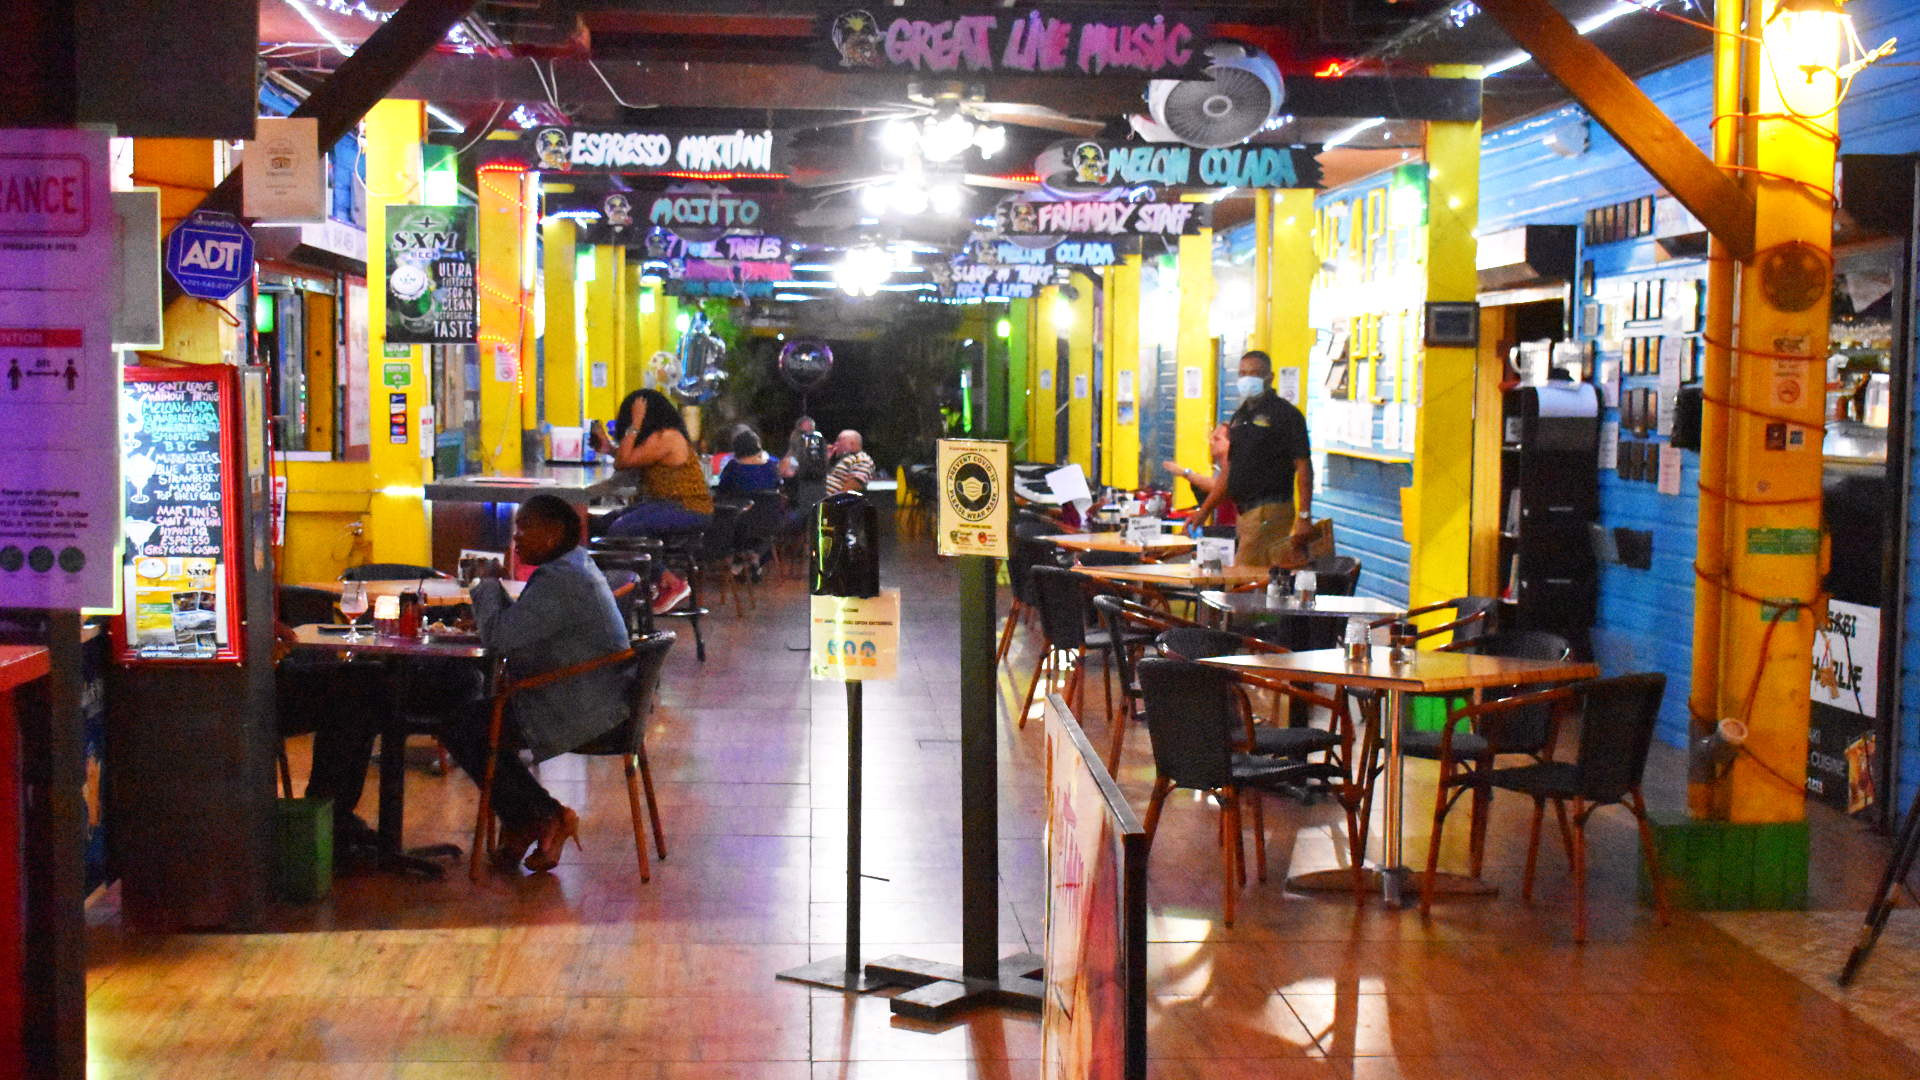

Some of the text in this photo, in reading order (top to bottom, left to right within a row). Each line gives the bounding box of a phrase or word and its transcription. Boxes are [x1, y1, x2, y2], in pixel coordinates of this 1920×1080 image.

[884, 15, 998, 72] GREAT
[570, 131, 671, 168] ESPRESSO
[1108, 146, 1299, 188] MELON COLADA
[0, 174, 78, 214] ANCE
[1135, 202, 1195, 235] STAFF
[392, 231, 458, 250] SXM
[181, 239, 241, 272] ADT
[1055, 242, 1115, 265] COLADA
[439, 262, 472, 277] ULTRA
[442, 299, 473, 311] CLEAN
[433, 321, 473, 338] TASTE
[134, 382, 156, 392] YOU
[186, 382, 214, 392] LEAVE
[185, 463, 214, 474] PETE
[169, 482, 211, 492] MANGO
[160, 535, 210, 547] ESPRESSO
